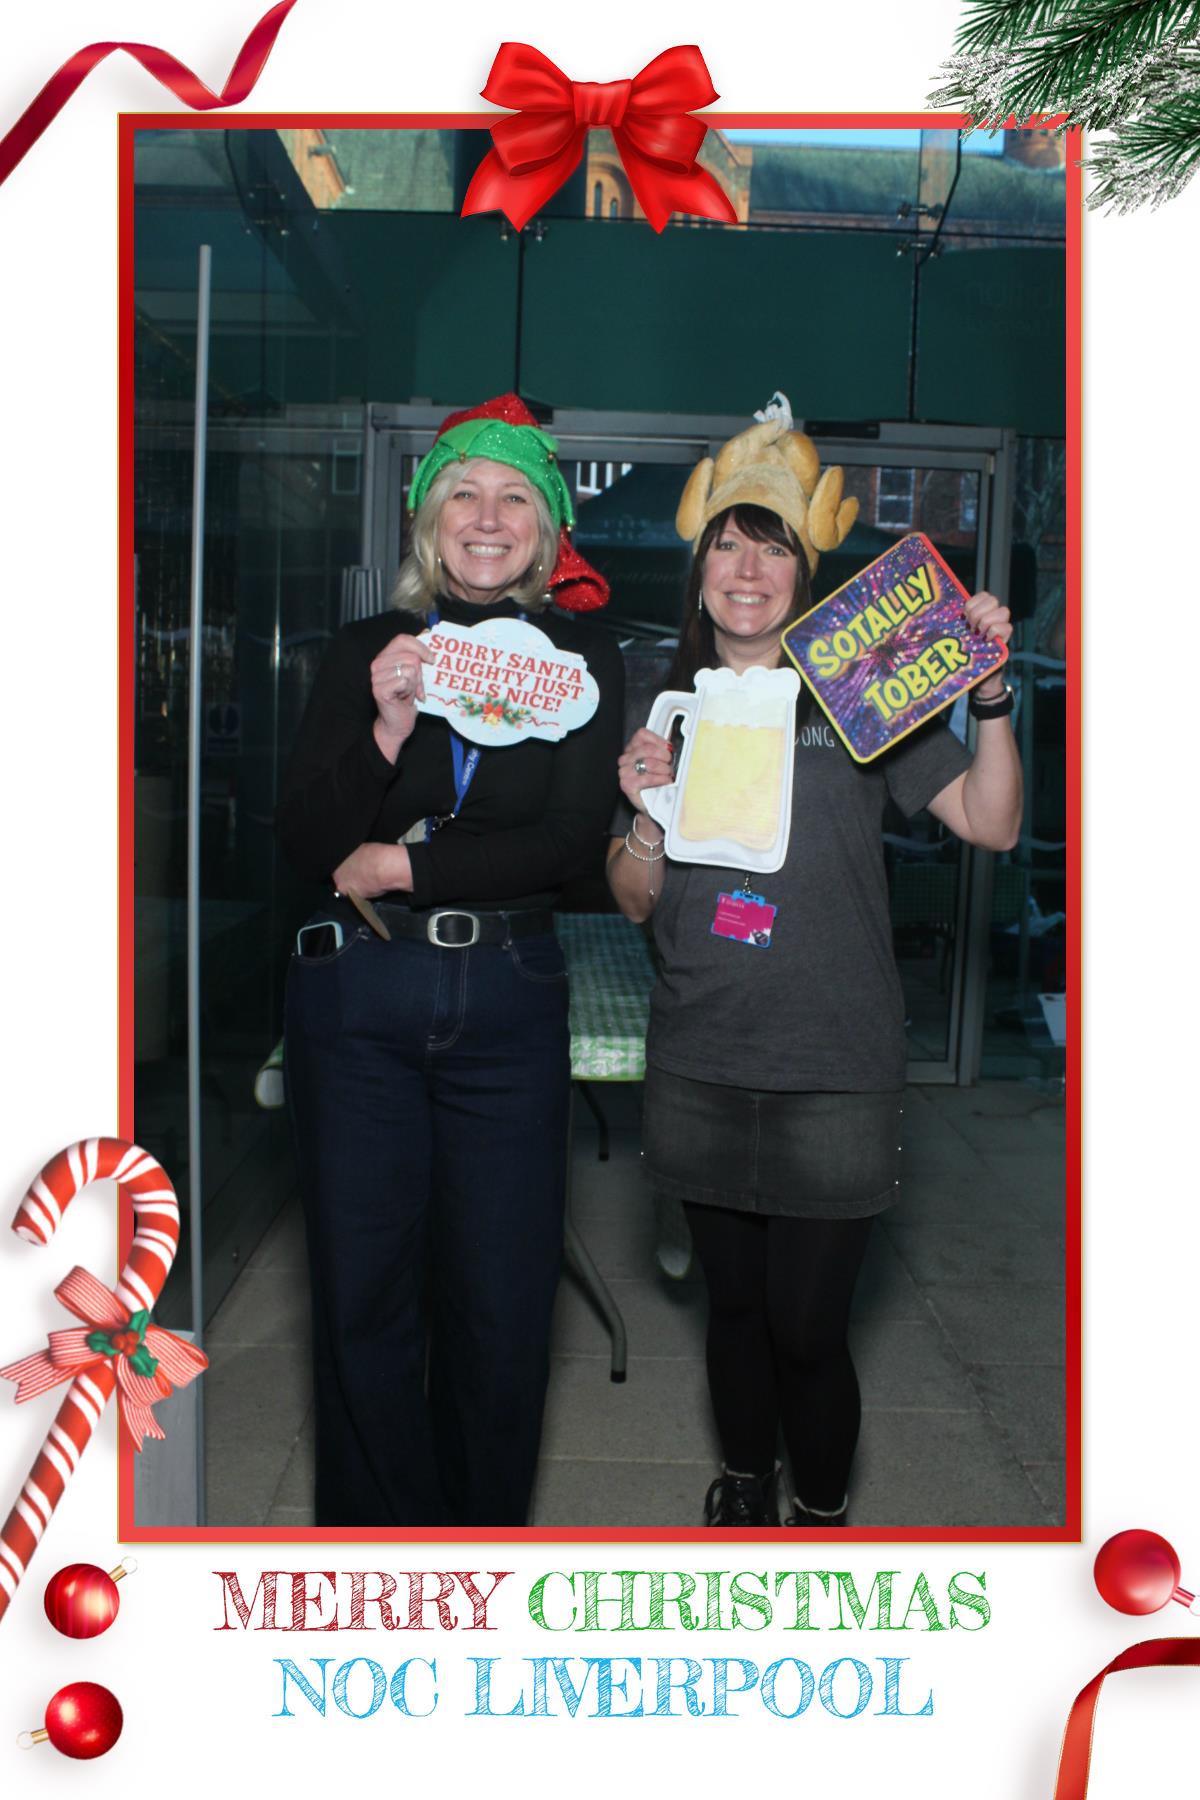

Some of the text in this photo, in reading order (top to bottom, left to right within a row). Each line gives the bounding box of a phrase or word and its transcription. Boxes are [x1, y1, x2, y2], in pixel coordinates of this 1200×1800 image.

[808, 564, 936, 678] SOTALLY
[428, 633, 583, 684] SORRY SANTA
[863, 637, 970, 721] TOBER
[433, 670, 563, 713] FEELS NICE!
[533, 676, 585, 700] JUST
[794, 725, 835, 748] ONG
